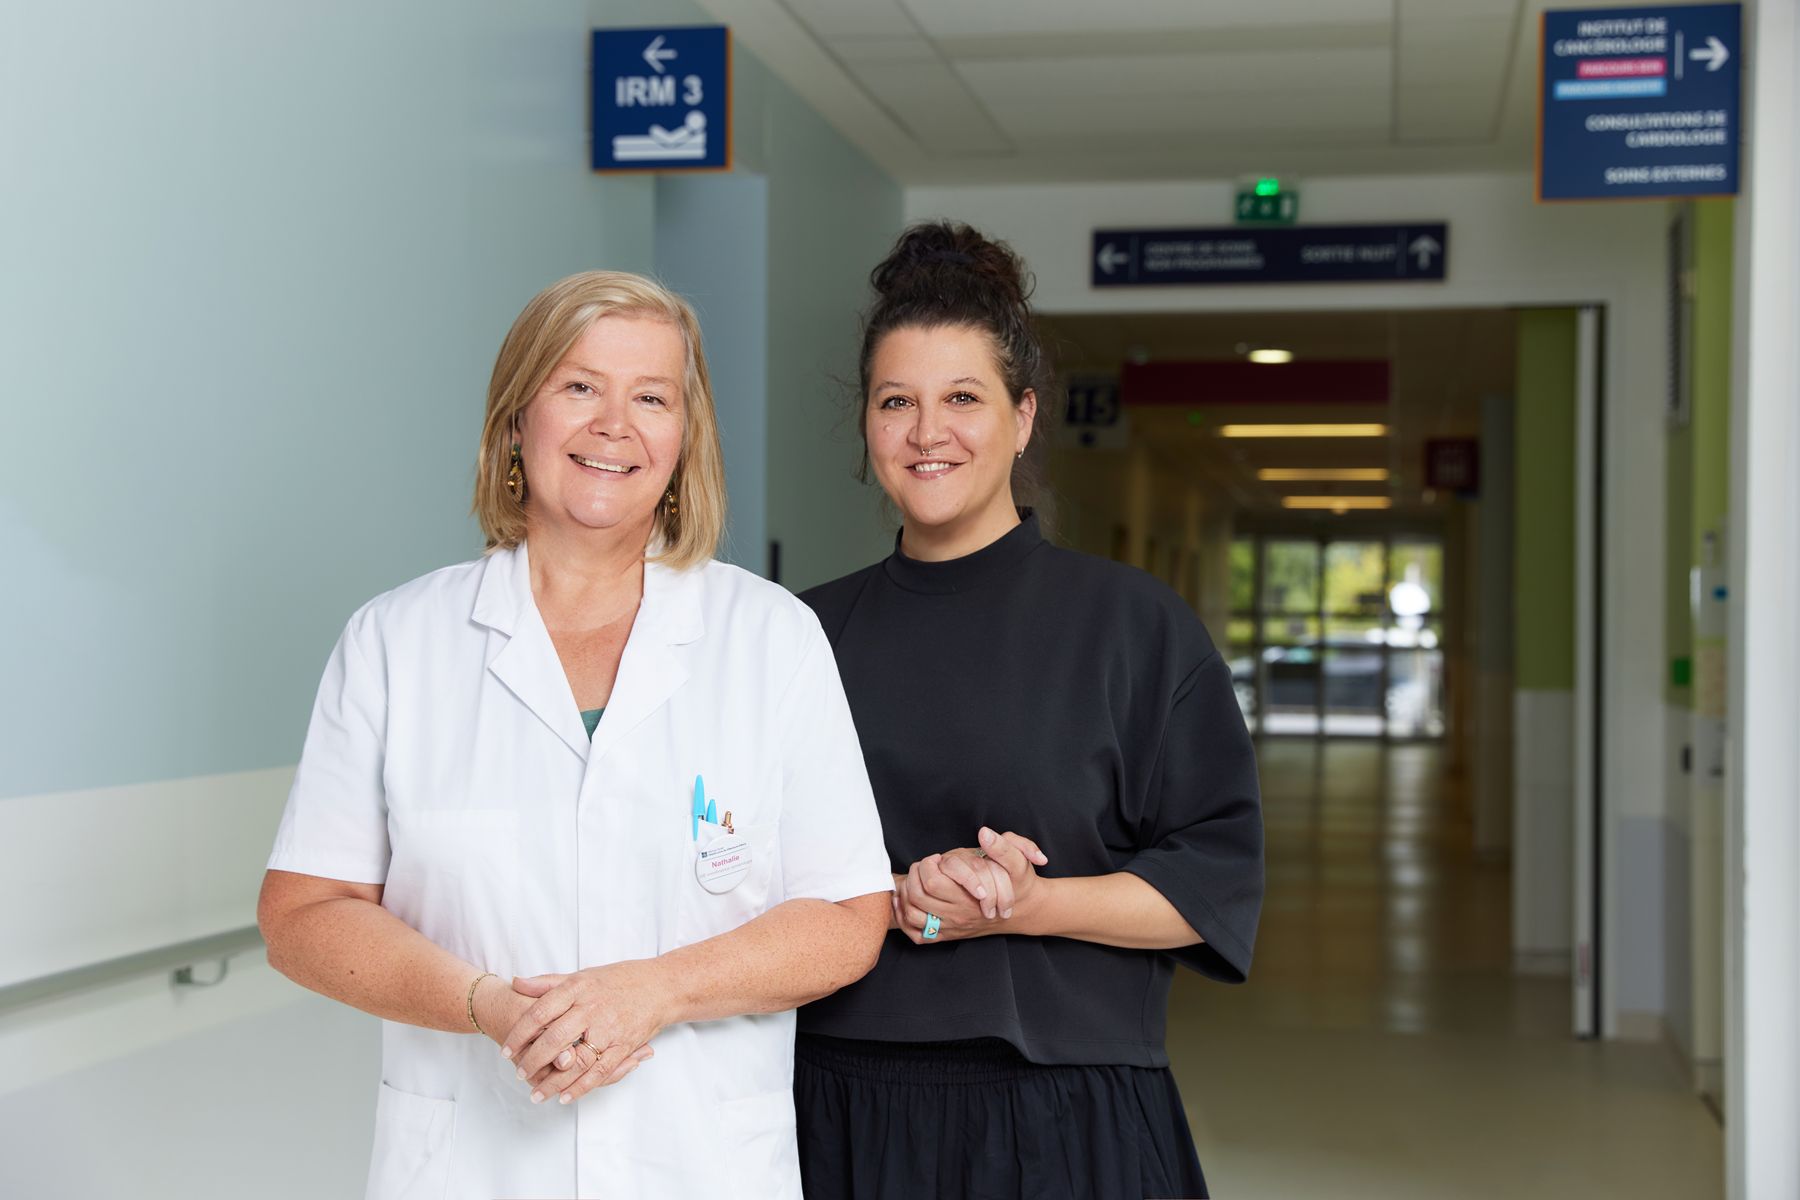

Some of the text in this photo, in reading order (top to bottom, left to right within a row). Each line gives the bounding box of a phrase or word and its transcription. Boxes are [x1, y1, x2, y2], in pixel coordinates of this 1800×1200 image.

[1577, 17, 1667, 36] INSTITUT DE
[616, 74, 703, 107] IRM 3
[1585, 110, 1727, 131] CONSULTATIONS DE
[1626, 129, 1727, 147] CARDIOLOGIE
[1604, 164, 1727, 184] SOINS EXTERNES
[711, 855, 740, 868] Nathalie
